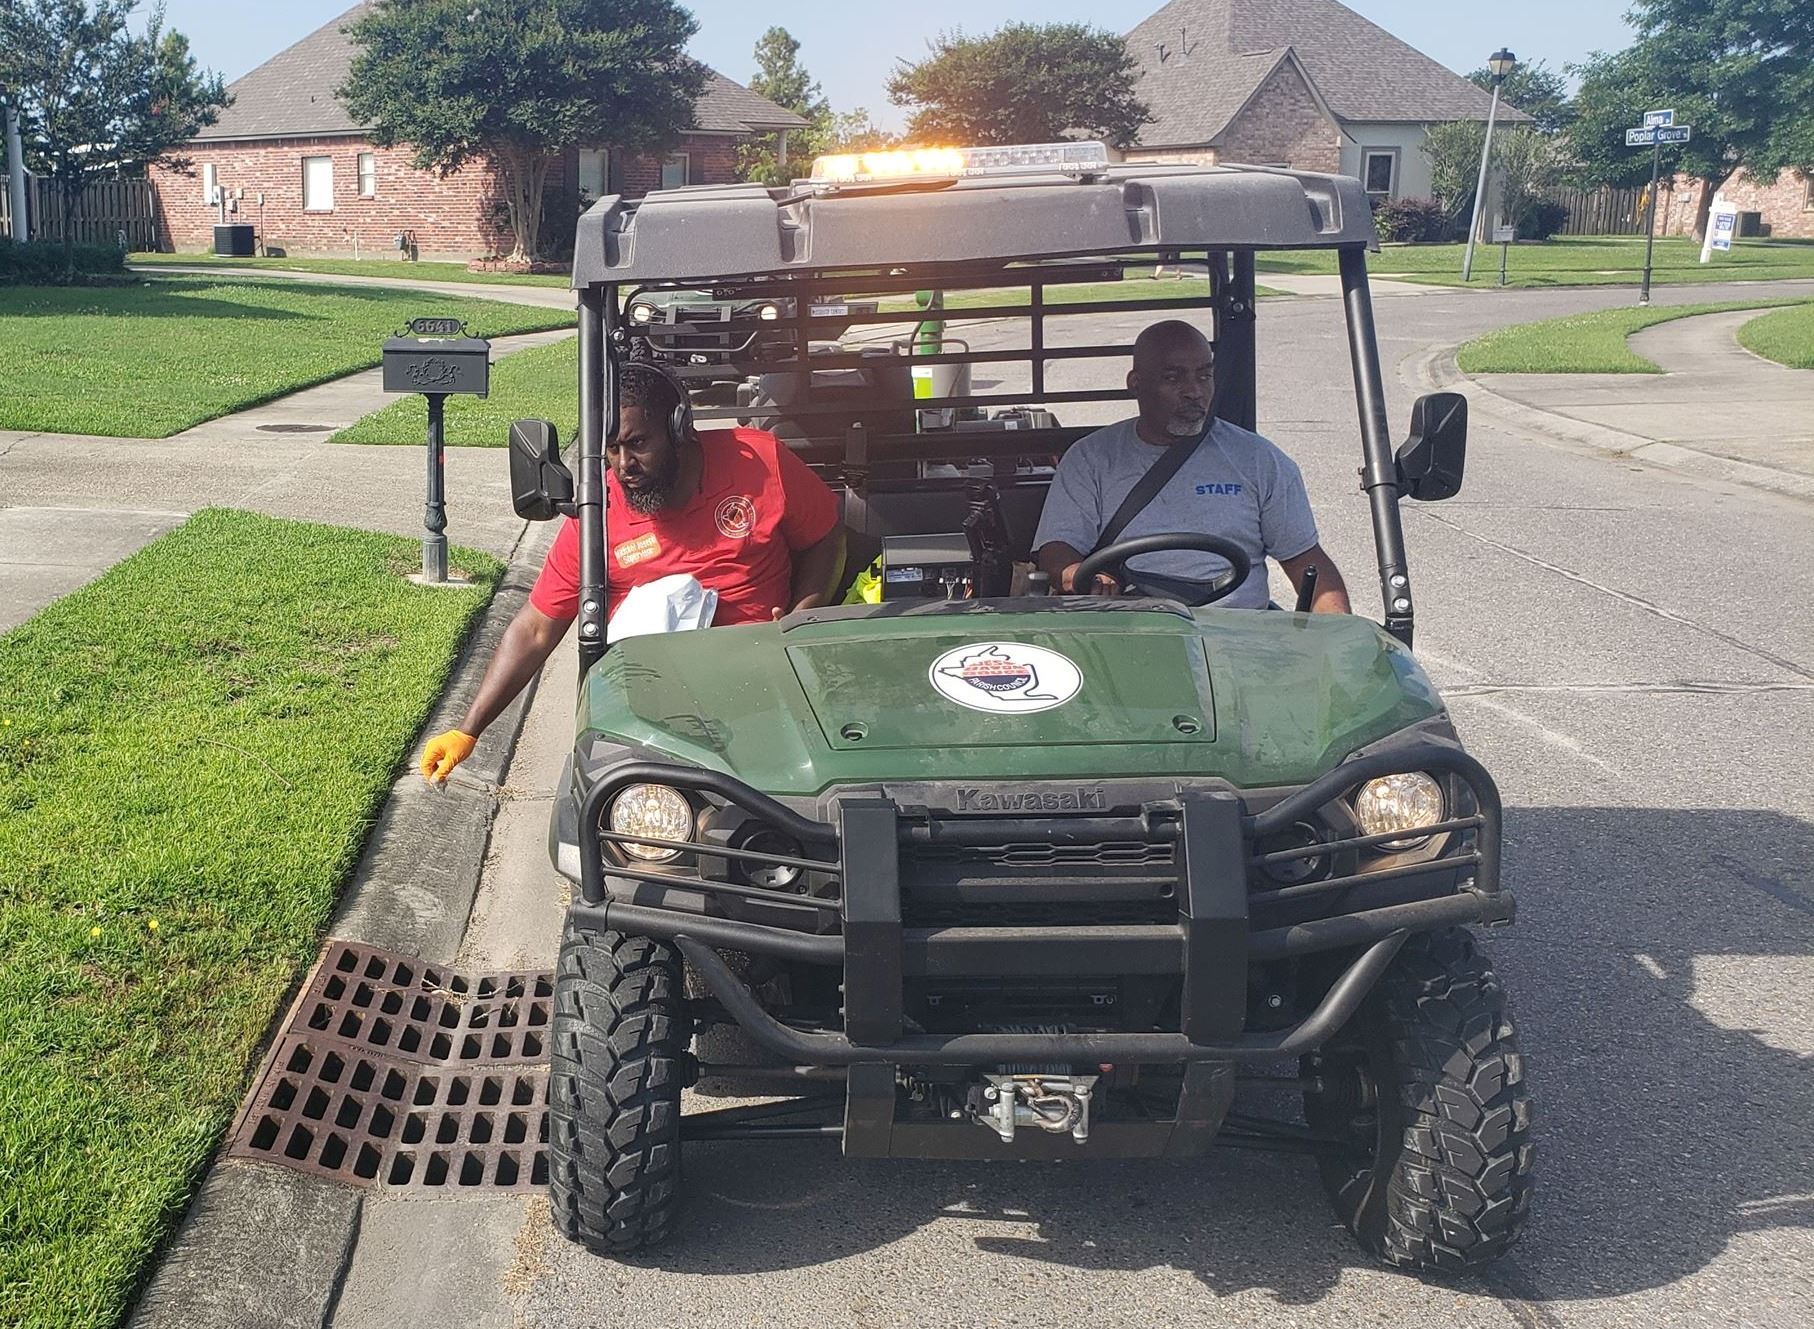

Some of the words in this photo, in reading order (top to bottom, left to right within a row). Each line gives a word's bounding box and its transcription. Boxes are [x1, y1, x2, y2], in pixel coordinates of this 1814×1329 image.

[1646, 114, 1664, 126] Alma
[1629, 130, 1655, 143] Poplar
[1657, 129, 1681, 141] Grove
[1195, 483, 1242, 496] STAFF
[956, 786, 1106, 812] Kawasaki
